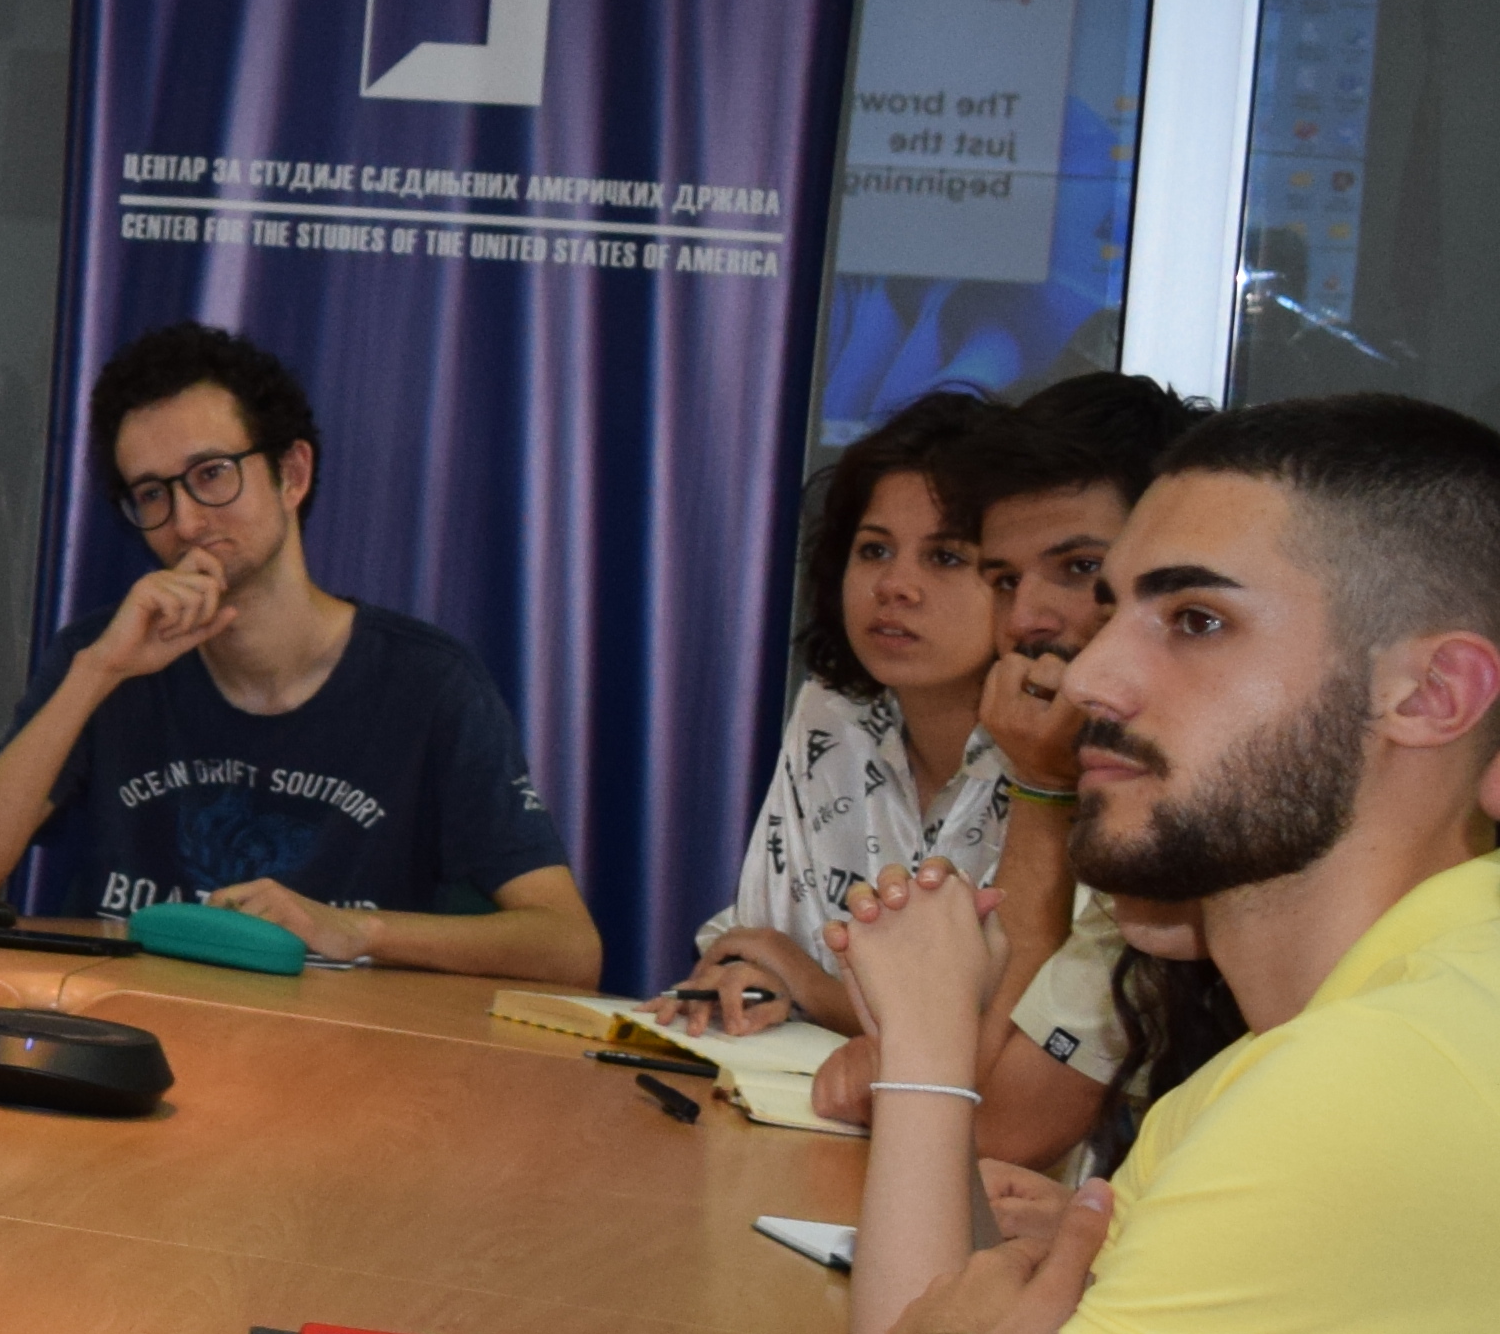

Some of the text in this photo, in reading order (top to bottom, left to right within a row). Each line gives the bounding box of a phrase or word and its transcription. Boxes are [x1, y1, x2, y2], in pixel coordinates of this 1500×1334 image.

[122, 152, 781, 217] ЦЕНТАР ЗА СТУДИЈЕ СЈЕДИЊЕНИХ АМЕРИЧКИХ ДРЖАВА
[120, 212, 780, 278] CENTER FOR THE STUDIES OF THE UNITED STATES OF AMERICA
[117, 758, 192, 810] OCEAN
[191, 757, 260, 790] DRIFT
